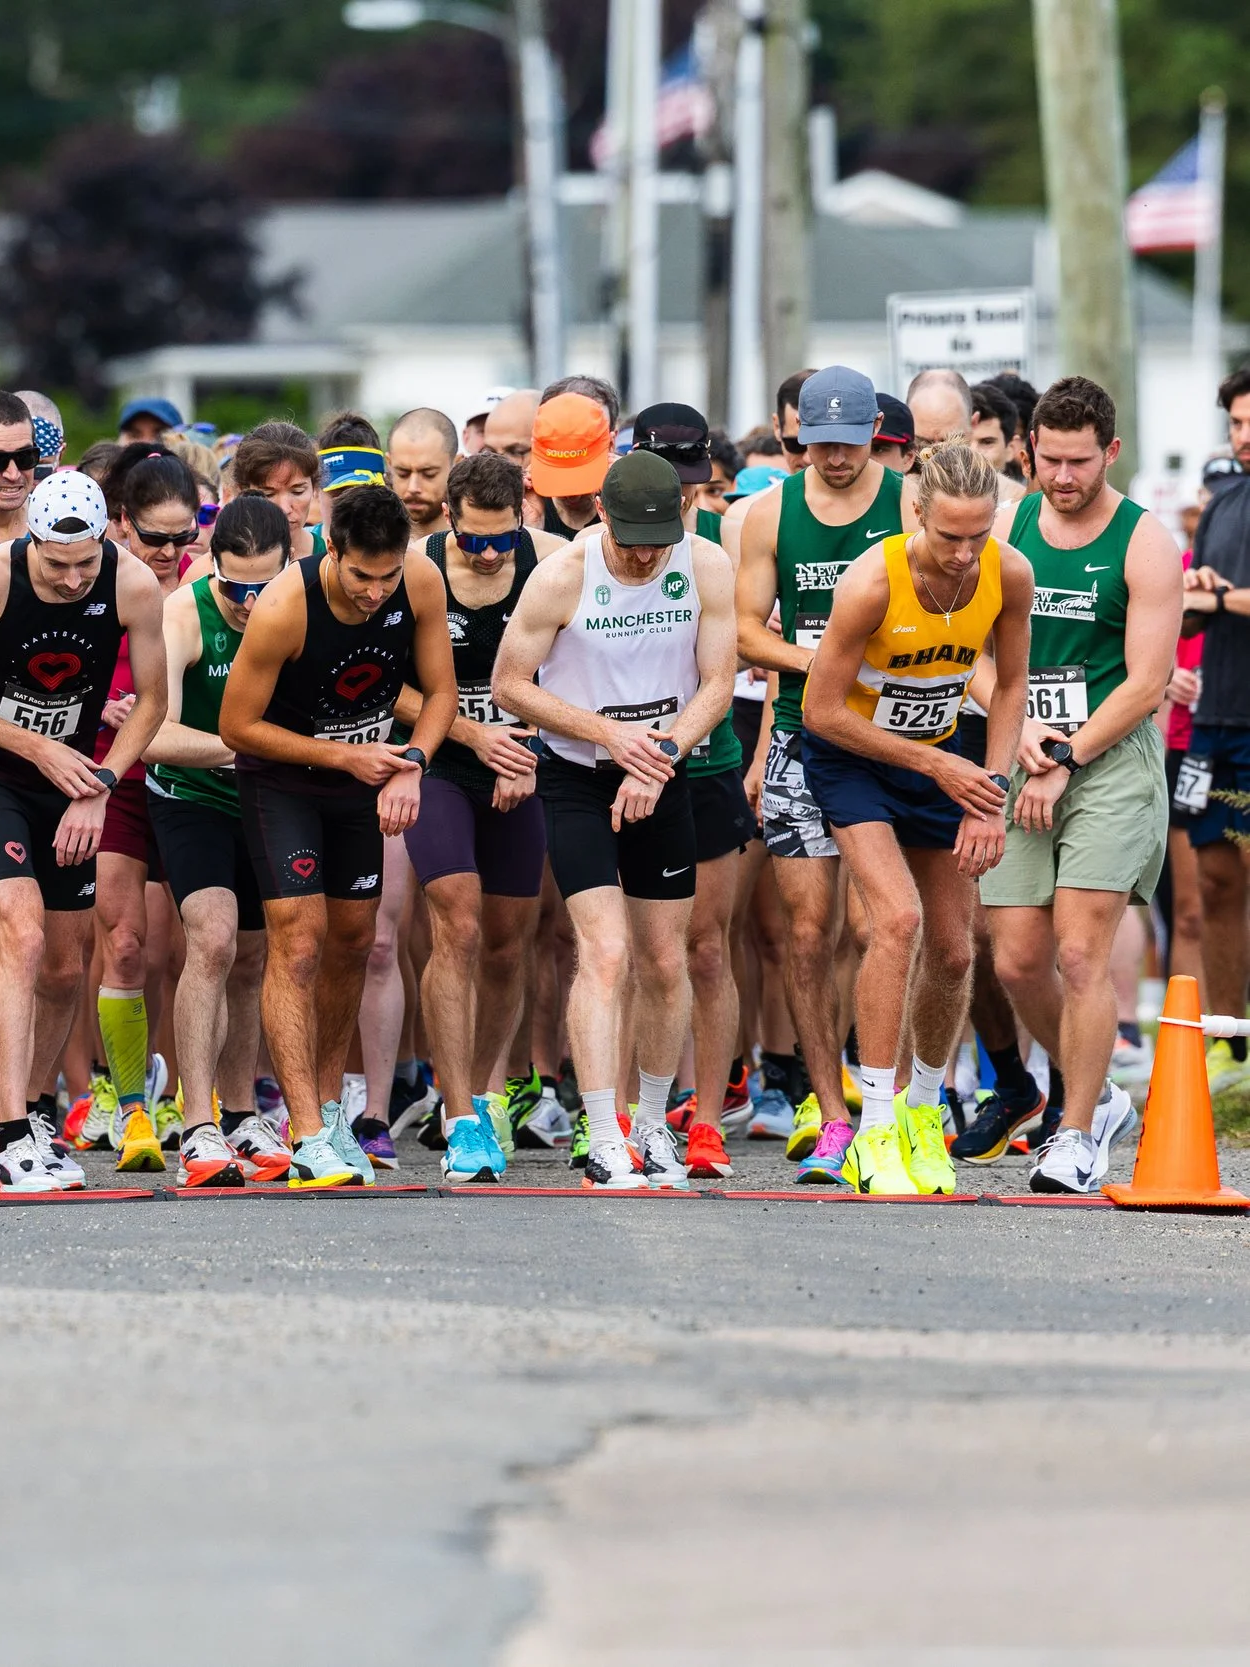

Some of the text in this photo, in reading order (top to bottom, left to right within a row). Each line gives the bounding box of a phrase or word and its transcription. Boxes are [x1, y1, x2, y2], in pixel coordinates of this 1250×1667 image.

[546, 447, 588, 459] saucony
[667, 579, 683, 593] KP
[796, 575, 842, 591] HAV
[1034, 590, 1054, 602] EW
[1032, 603, 1066, 615] AVEN
[586, 609, 693, 631] MANCHESTER
[804, 619, 818, 627] RAT
[21, 631, 93, 650] HARTBEAT
[606, 629, 645, 639] RUNNING
[1041, 673, 1064, 681] Timing
[13, 691, 68, 707] RAT Race Timing
[891, 689, 946, 699] RAT Race Timing
[604, 707, 660, 719] RAT Race Timing
[888, 701, 949, 728] 525
[12, 705, 68, 736] 556
[324, 716, 377, 731] RAT Race Timing
